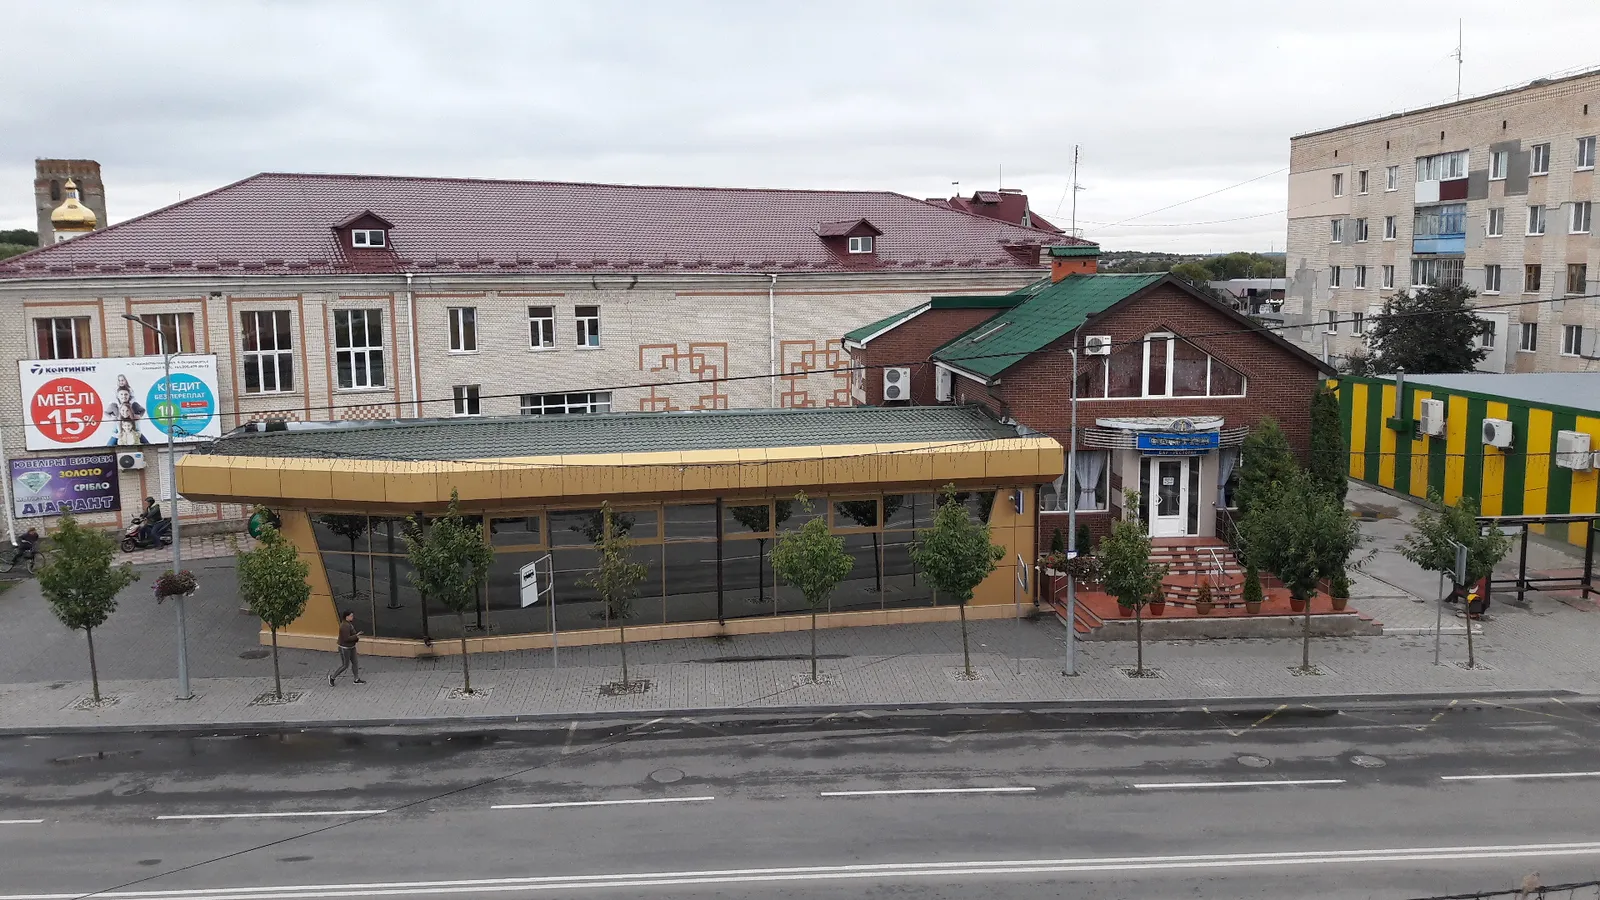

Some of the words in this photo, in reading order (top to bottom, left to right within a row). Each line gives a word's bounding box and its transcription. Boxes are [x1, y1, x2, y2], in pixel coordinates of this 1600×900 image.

[45, 366, 96, 374] КОНТИНЕНТ
[37, 392, 94, 407] МЕБЛІ
[13, 458, 67, 469] ЮВЕЛІРНІ
[70, 455, 113, 466] ВИРОБИ
[59, 468, 102, 478] ЗОЛОТО
[73, 482, 110, 491] СРІБЛО
[21, 495, 114, 515] ДІАМАНТ
